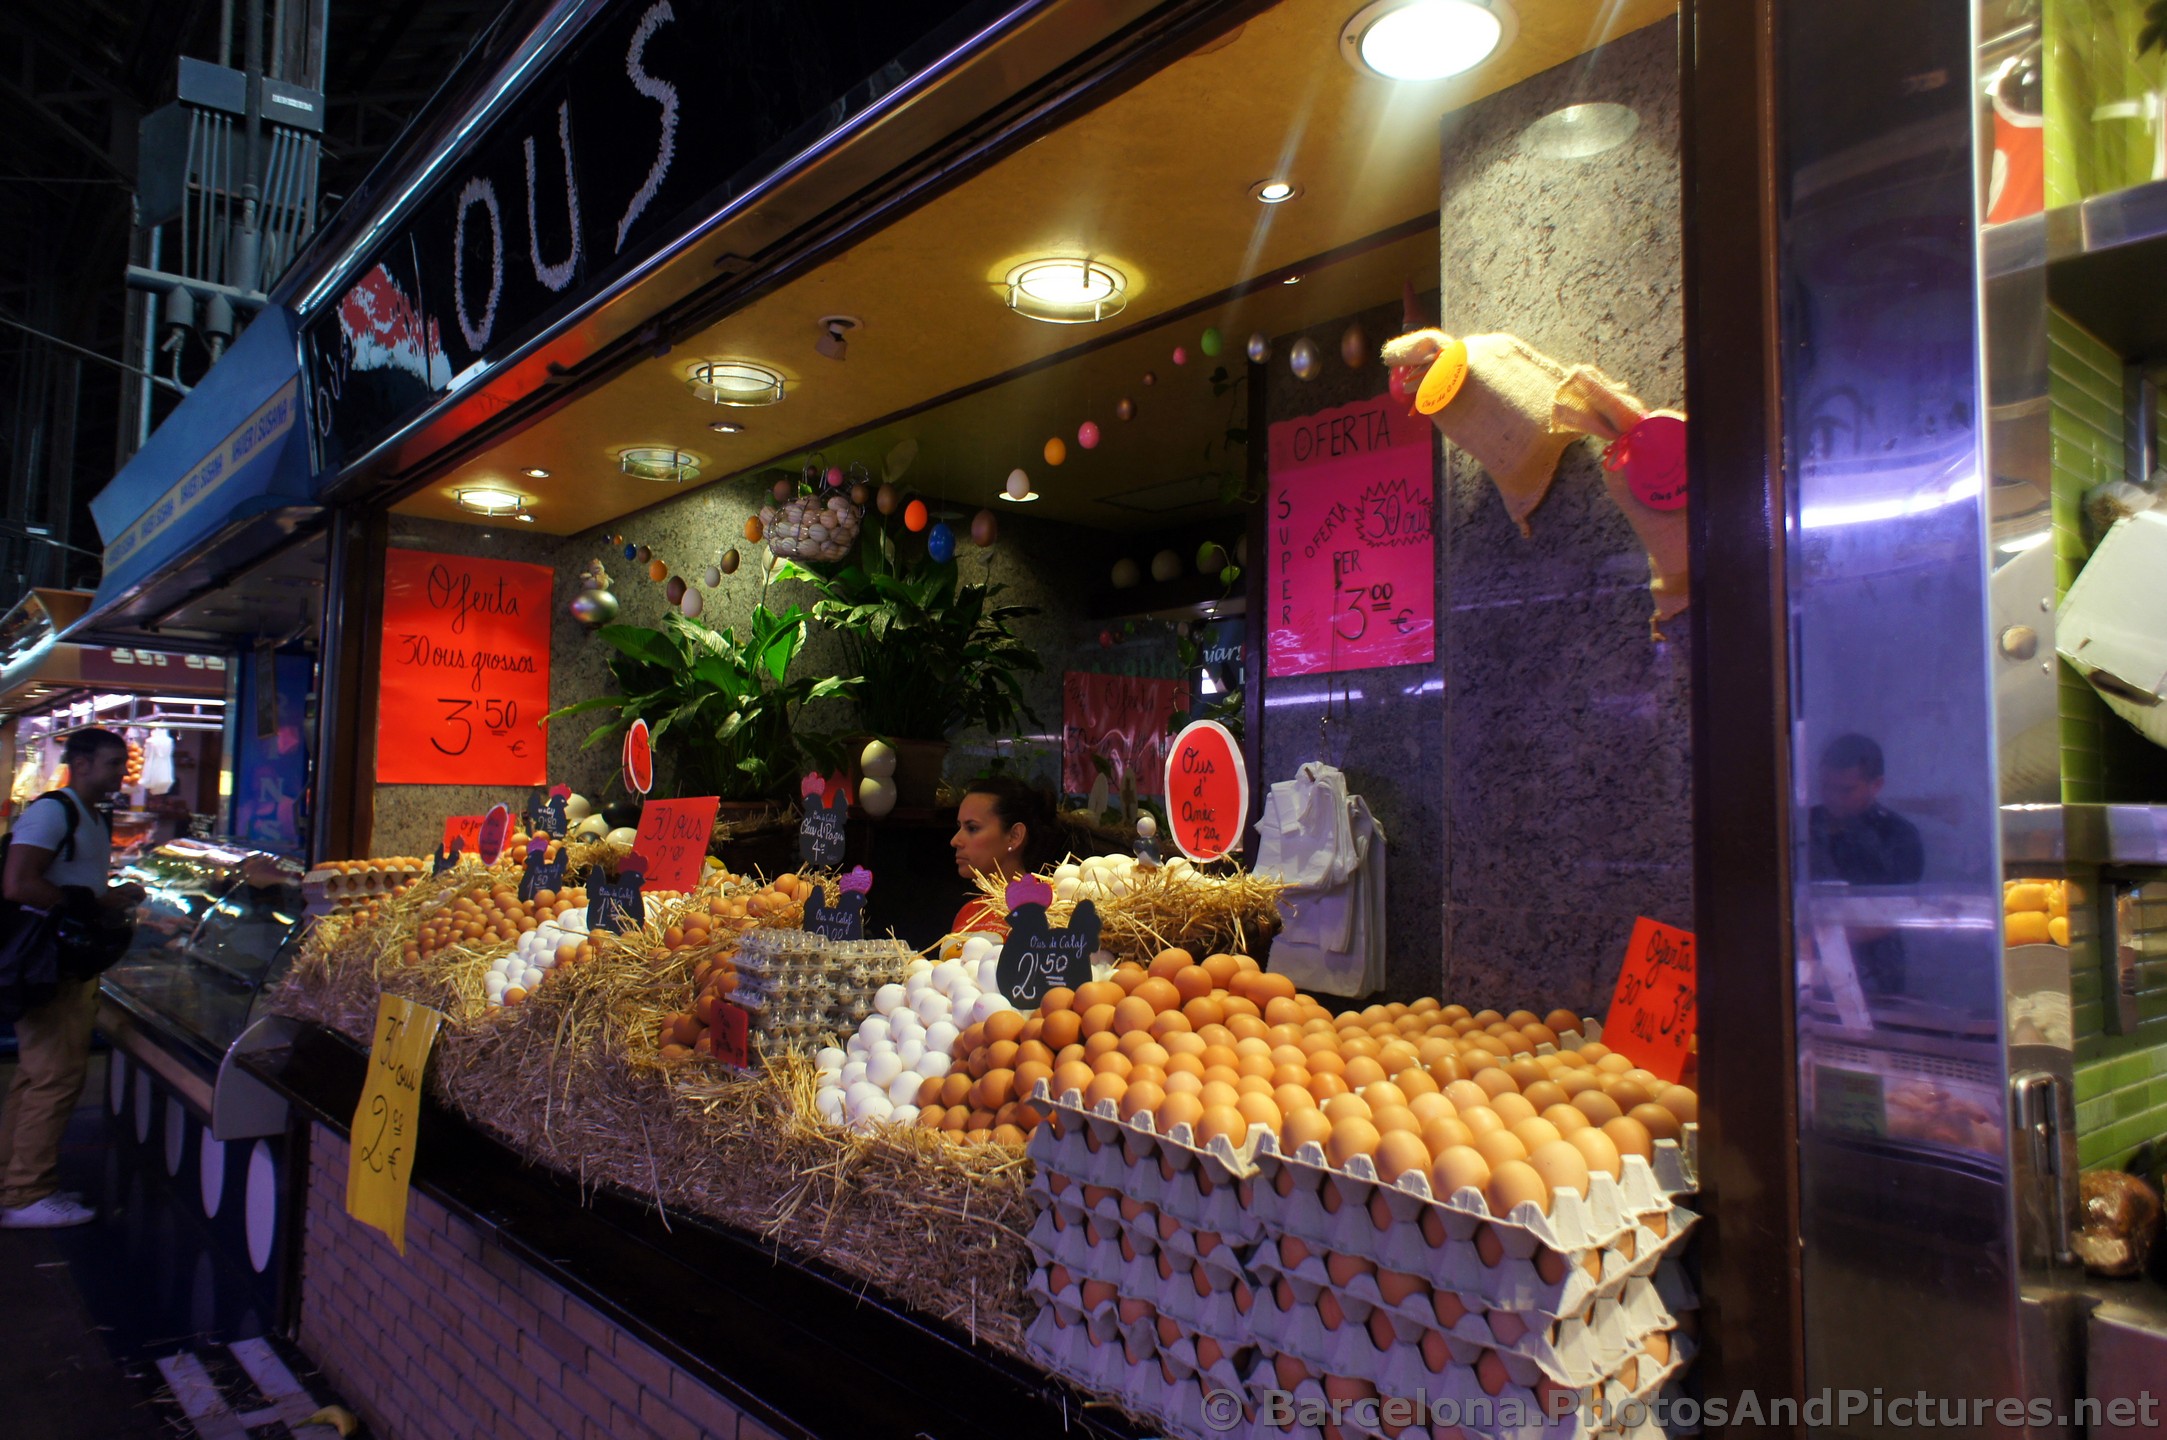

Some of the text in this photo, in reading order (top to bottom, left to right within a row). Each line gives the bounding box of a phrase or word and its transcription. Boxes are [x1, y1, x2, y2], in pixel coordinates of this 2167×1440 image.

[454, 0, 680, 352] OUS
[1294, 409, 1391, 462] OFERTA
[1304, 501, 1352, 560] OFERTA
[1367, 495, 1400, 540] 30
[1277, 489, 1292, 626] SUPER
[428, 564, 520, 635] Oferta
[396, 634, 538, 693] 30 ous grossos
[1182, 747, 1216, 774] Ous
[1030, 933, 1088, 959] Ous de Calaf
